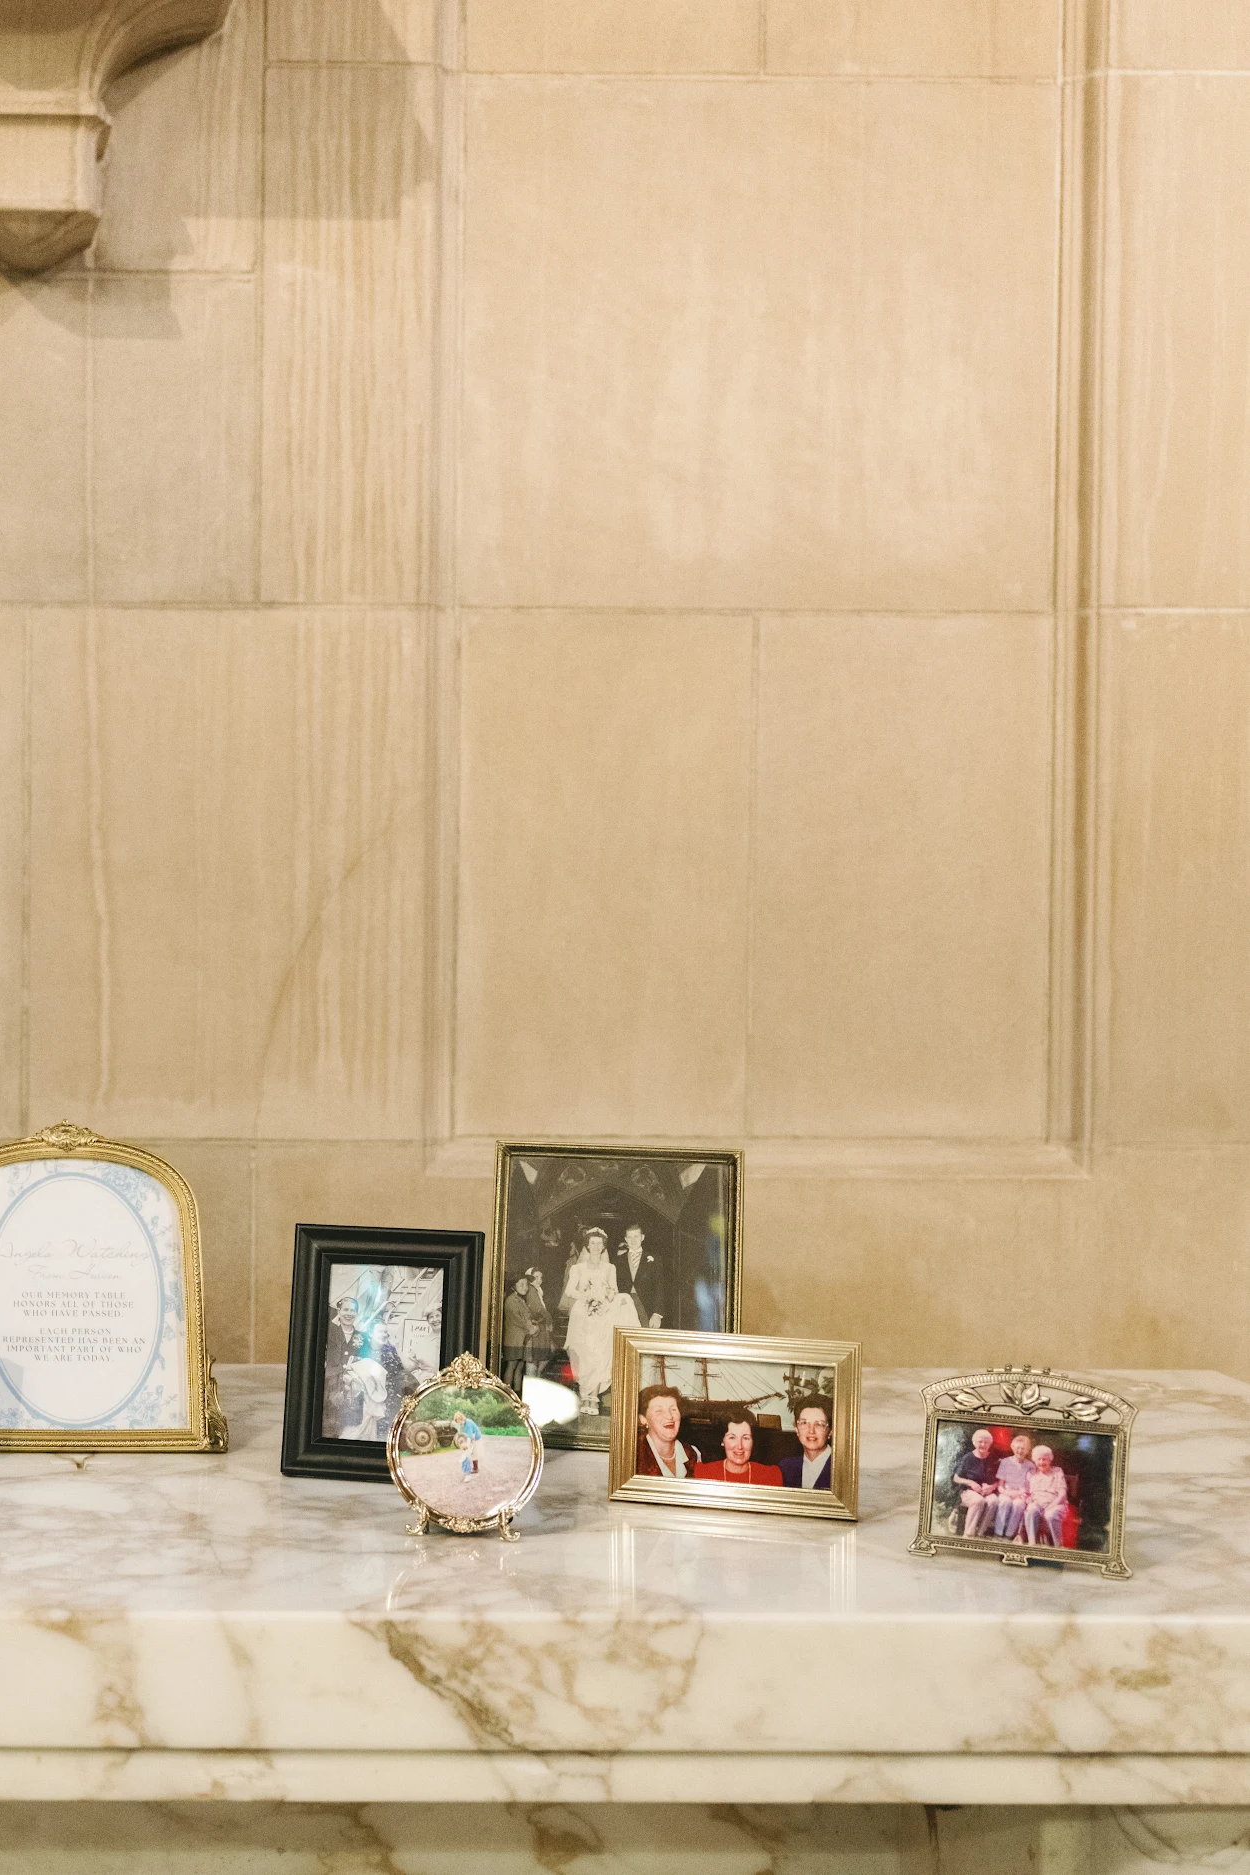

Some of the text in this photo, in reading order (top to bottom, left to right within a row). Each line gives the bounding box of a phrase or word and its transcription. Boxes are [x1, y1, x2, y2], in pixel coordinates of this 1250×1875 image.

[21, 1291, 126, 1300] OUR MEMORY TABLE
[13, 1300, 57, 1308] HONORS
[101, 1301, 134, 1309] THOSE
[23, 1309, 125, 1318] WHO HAVE PASSED.
[39, 1327, 112, 1335] EACH PERSON
[2, 1335, 146, 1345] REPRESENTED HAS BEEN AN
[6, 1345, 66, 1353] IMPORTANT
[70, 1345, 96, 1353] PART
[117, 1346, 142, 1354] WHO
[34, 1354, 115, 1362] WE ARE TODAY.
